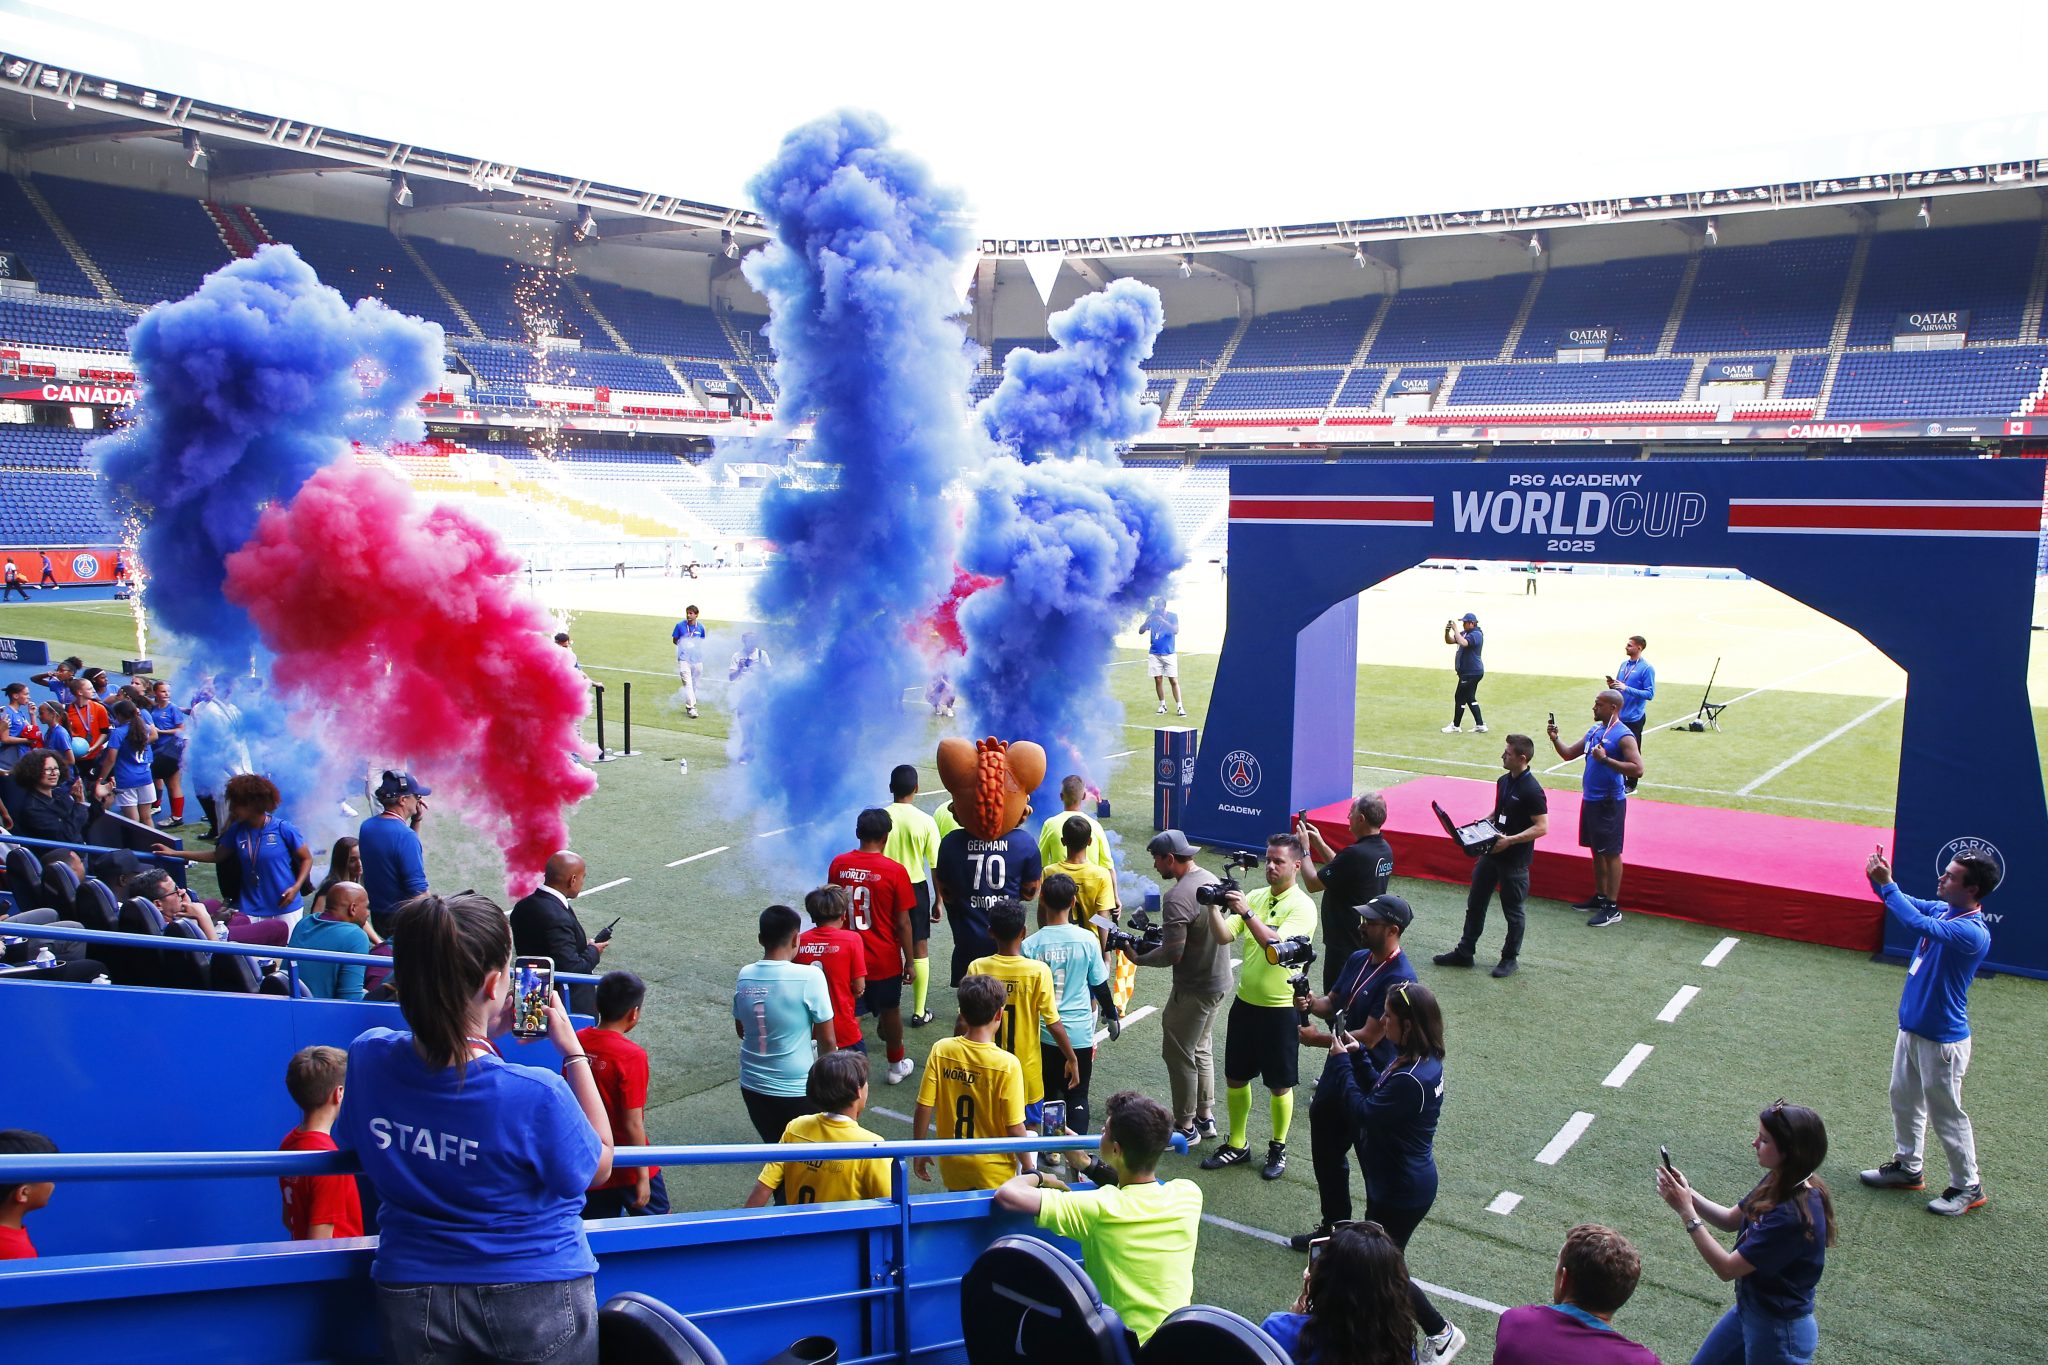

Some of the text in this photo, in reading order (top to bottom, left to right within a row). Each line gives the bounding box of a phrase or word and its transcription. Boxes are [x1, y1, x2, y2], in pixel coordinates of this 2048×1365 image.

[1909, 313, 1957, 326] QATAR
[1921, 324, 1957, 332] AIRWAYS
[1569, 330, 1607, 342] QATAR
[1722, 365, 1754, 376] QATAR
[705, 381, 727, 390] QATAR
[1401, 380, 1429, 388] QATAR
[42, 384, 136, 405] CANADA
[1540, 427, 1600, 440] CANADA
[1787, 424, 1863, 438] CANADA
[1509, 474, 1643, 487] PSG ACADEMY
[1547, 539, 1596, 552] 2025
[1181, 757, 1194, 769] ICI
[1228, 752, 1255, 766] PARIS
[1218, 803, 1262, 816] ACADEMY
[967, 840, 1008, 851] GERMAIN
[1949, 839, 1995, 857] PARIS
[840, 870, 866, 881] WORLD
[967, 854, 1006, 890] 70
[844, 885, 872, 931] 13
[799, 945, 825, 954] WORLD
[753, 1002, 767, 1056] 1
[944, 1068, 976, 1084] WORLD
[369, 1117, 479, 1167] STAFF
